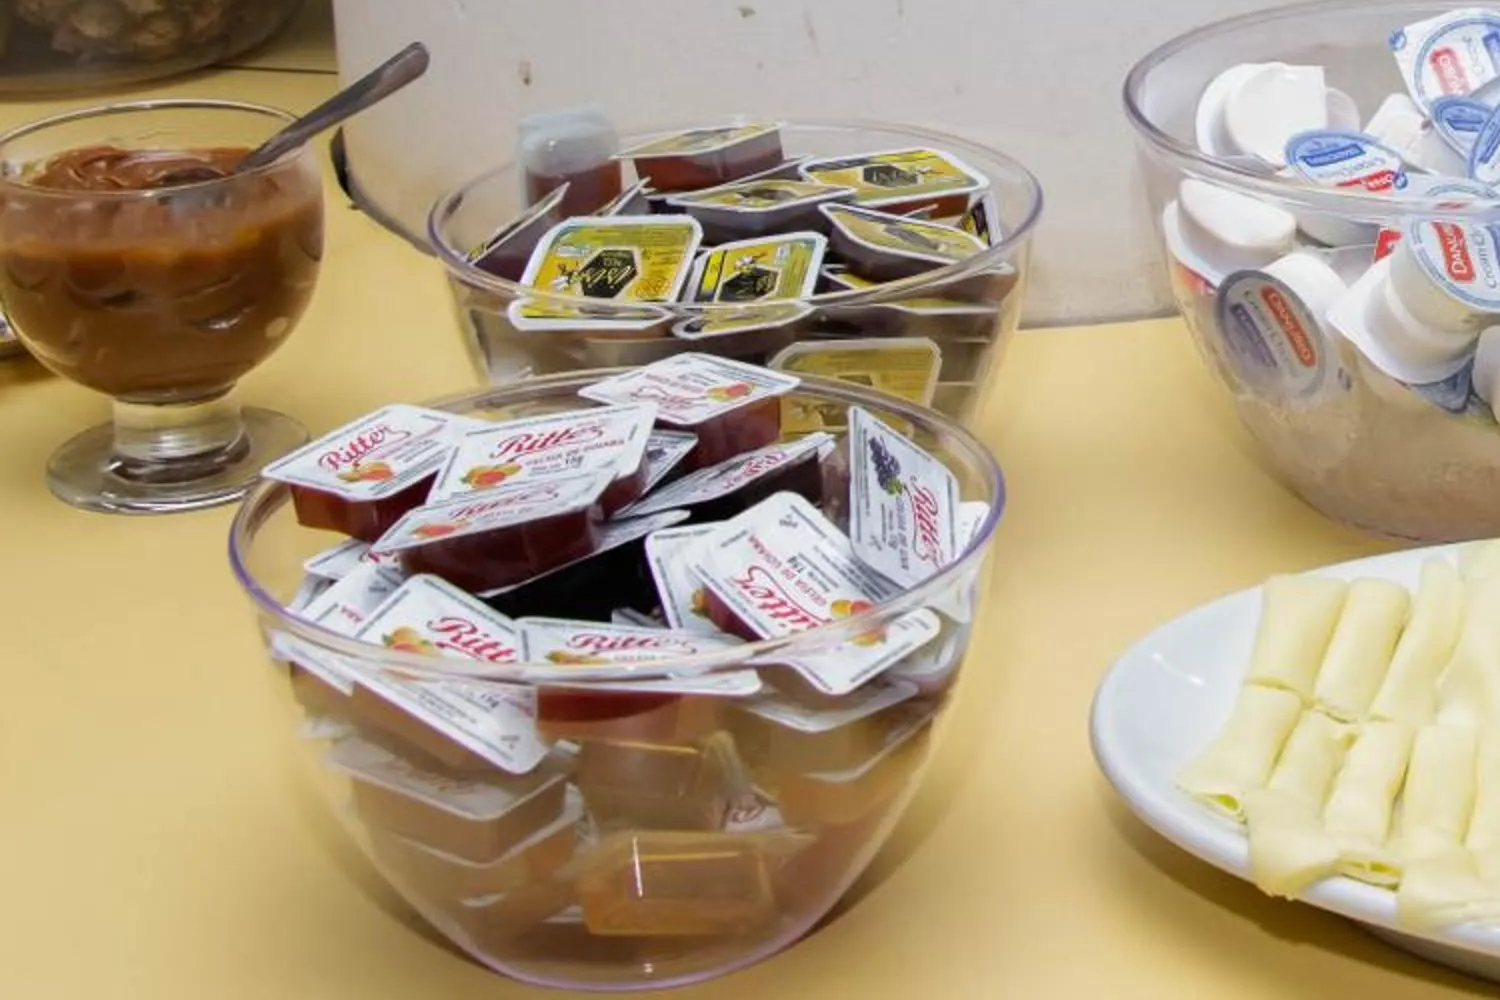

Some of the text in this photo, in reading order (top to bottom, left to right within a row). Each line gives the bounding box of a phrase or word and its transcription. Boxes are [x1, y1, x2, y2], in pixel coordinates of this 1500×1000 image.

[318, 424, 411, 473] Ritter
[490, 423, 606, 461] Ritter
[730, 565, 833, 632] itter
